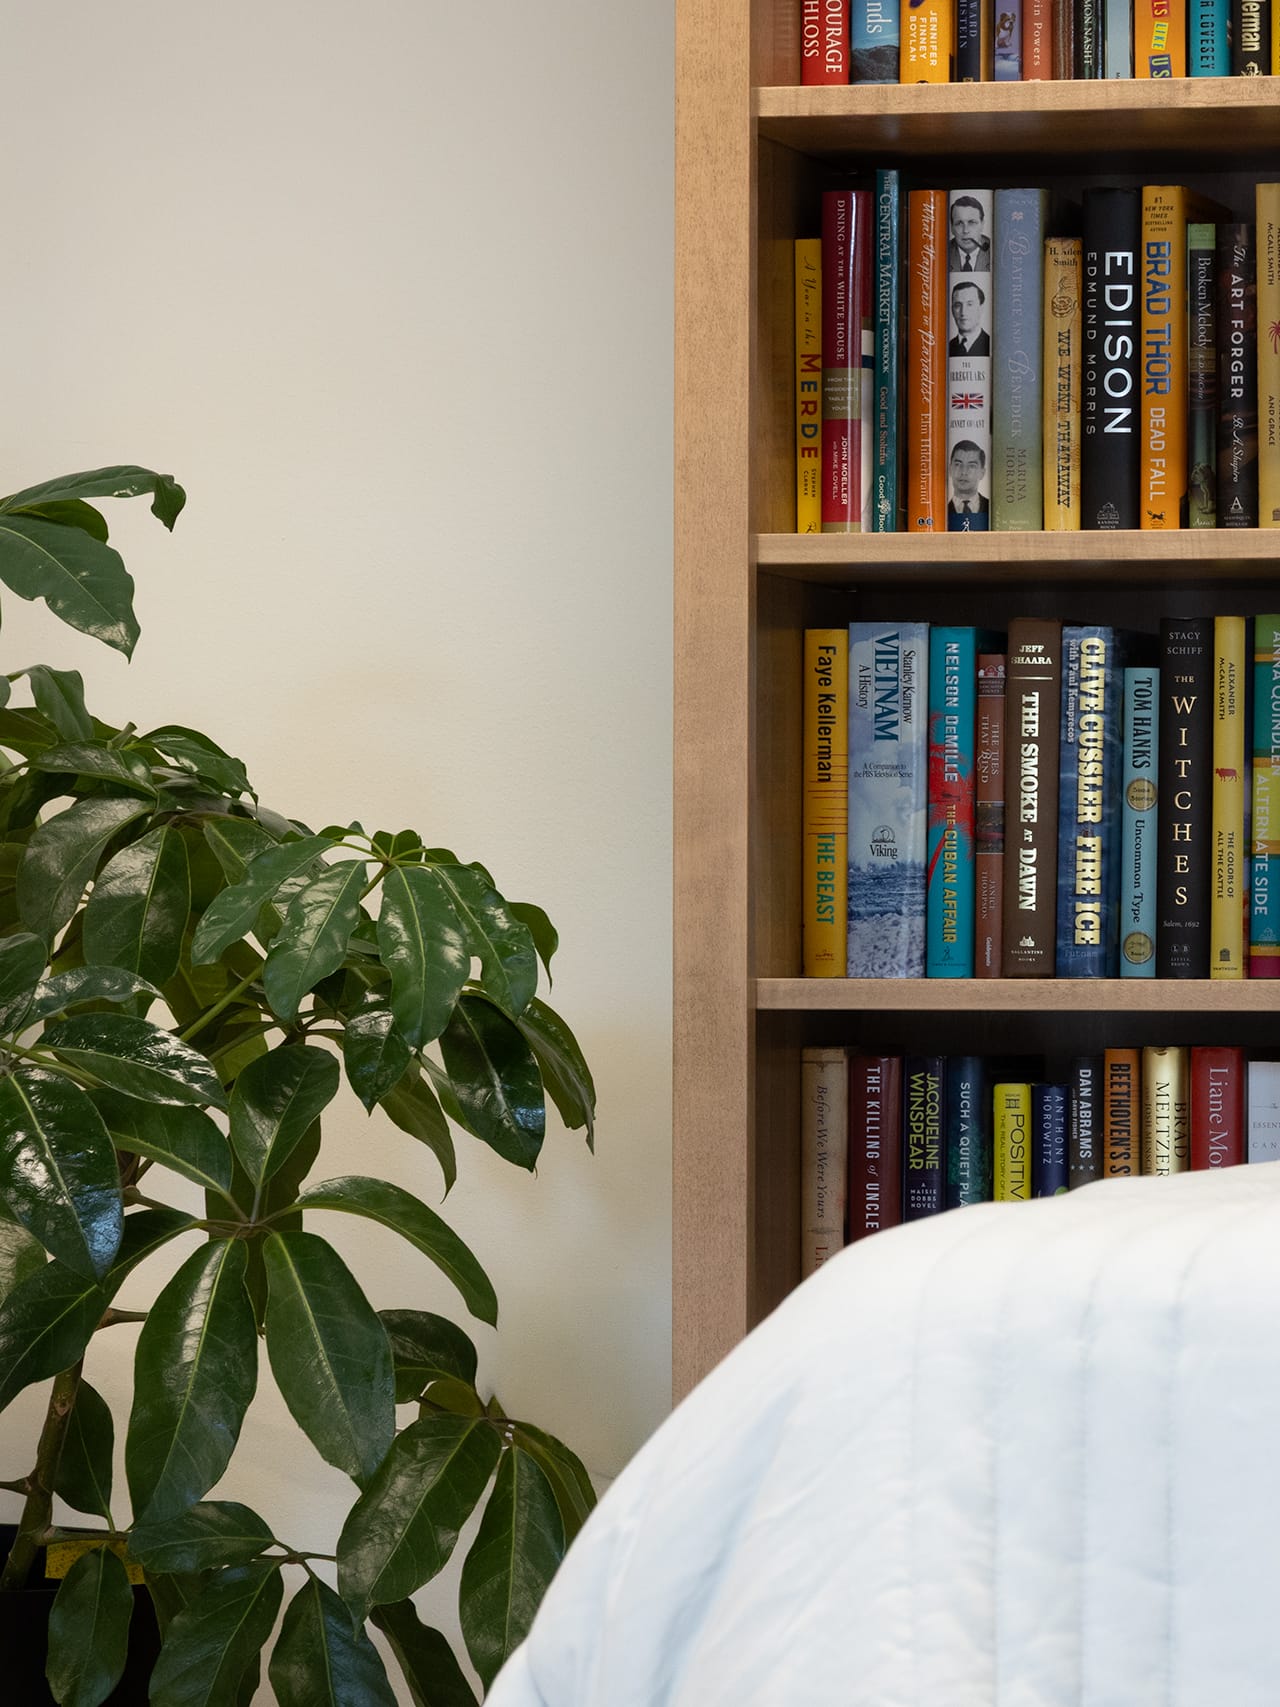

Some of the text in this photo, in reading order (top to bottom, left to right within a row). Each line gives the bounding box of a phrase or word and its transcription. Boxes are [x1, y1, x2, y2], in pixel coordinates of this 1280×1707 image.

[909, 15, 917, 62] BOYLAN
[919, 17, 928, 60] FINNEY
[929, 10, 938, 67] JENNIFER
[1033, 22, 1043, 67] Powers
[1083, 27, 1093, 66] NASHT
[1152, 22, 1168, 50] LIKE
[1200, 14, 1215, 70] LOVESEY
[836, 200, 846, 242] DINING
[838, 245, 845, 257] AT
[1145, 241, 1172, 316] BRAD
[1267, 257, 1275, 287] SMITH
[836, 281, 846, 320] WHITE
[879, 193, 892, 374] CENTRAL MARKET COOKBOOK
[917, 202, 937, 406] What Happens Paradise
[1193, 256, 1212, 350] Broken Melody
[804, 328, 816, 346] the
[836, 322, 846, 361] HOUSE
[1007, 235, 1037, 438] BEATRICE AND BENEDICK
[1086, 251, 1098, 435] EDMUND MORRIS
[1103, 251, 1134, 434] EDISON
[1231, 245, 1247, 400] The ART FORGER
[1145, 322, 1172, 396] THOR
[800, 353, 821, 459] MERDE
[880, 386, 889, 410] Good
[880, 412, 889, 428] and
[1057, 329, 1071, 509] WE WENT THATAWAY
[1268, 395, 1276, 447] AND GRACE
[841, 436, 849, 506] JOHN MOELLER
[920, 442, 932, 504] Hilderbrand
[1005, 447, 1016, 504] FIORATO
[1018, 448, 1027, 502] MARINA
[1149, 407, 1167, 502] DEAD FALL
[1229, 446, 1244, 484] Shapiro
[878, 474, 887, 500] Good
[1011, 656, 1053, 665] SHAARA
[1019, 644, 1045, 654] JEFF
[1167, 646, 1203, 655] SCHIFF
[1168, 631, 1201, 640] STACY
[856, 664, 872, 710] A History
[874, 632, 900, 743] VIETNAM
[900, 649, 917, 725] Stanley Karnow
[944, 642, 960, 708] NELSON
[1066, 639, 1079, 744] with Paul Kemprecos
[1079, 637, 1106, 712] CLIVE
[1134, 677, 1153, 712] TOM
[1174, 675, 1195, 683] THE
[1227, 661, 1236, 716] ALEXANDER
[814, 645, 837, 783] Faye Kellerman
[1218, 691, 1226, 720] SMITH
[978, 715, 993, 784] THAT BIND
[991, 722, 1000, 776] THE TIES
[1077, 713, 1105, 824] CUSSLER
[1132, 716, 1153, 769] HANKS
[946, 804, 957, 826] THE
[1018, 691, 1040, 912] THE SMOKE AT DAWN
[1171, 695, 1198, 906] WITCHES
[869, 844, 898, 860] Viking
[943, 829, 958, 884] CUBAN
[1074, 835, 1103, 896] FIRE
[1131, 819, 1146, 924] Uncommon Type
[1216, 830, 1225, 899] ALL THE CATTLE
[1226, 831, 1235, 899] THE COLORS OF
[1254, 773, 1272, 916] ALTERNATE SIDE
[817, 833, 836, 925] THE BEAST
[981, 871, 990, 920] THOMPSON
[988, 878, 997, 912] JANICE
[943, 888, 958, 945] AFFAIR
[1074, 901, 1102, 946] ICE
[909, 1072, 926, 1170] WINSPEAR
[924, 1072, 940, 1170] JACQUELINE
[960, 1082, 971, 1119] SUCH
[1079, 1069, 1093, 1159] DAN ABRAMS
[1109, 1062, 1132, 1161] BEETHOVEN'S
[1208, 1066, 1229, 1125] Liane
[811, 1085, 830, 1218] Before We Were Yours
[864, 1066, 881, 1230] THE KILLING of UNCLE
[960, 1123, 971, 1132] A
[1043, 1095, 1052, 1166] HOROWITZ
[1055, 1095, 1064, 1165] ANTHONY
[1155, 1081, 1170, 1177] MELTZER
[1174, 1101, 1188, 1158] BRAD
[958, 1136, 971, 1178] QUIET
